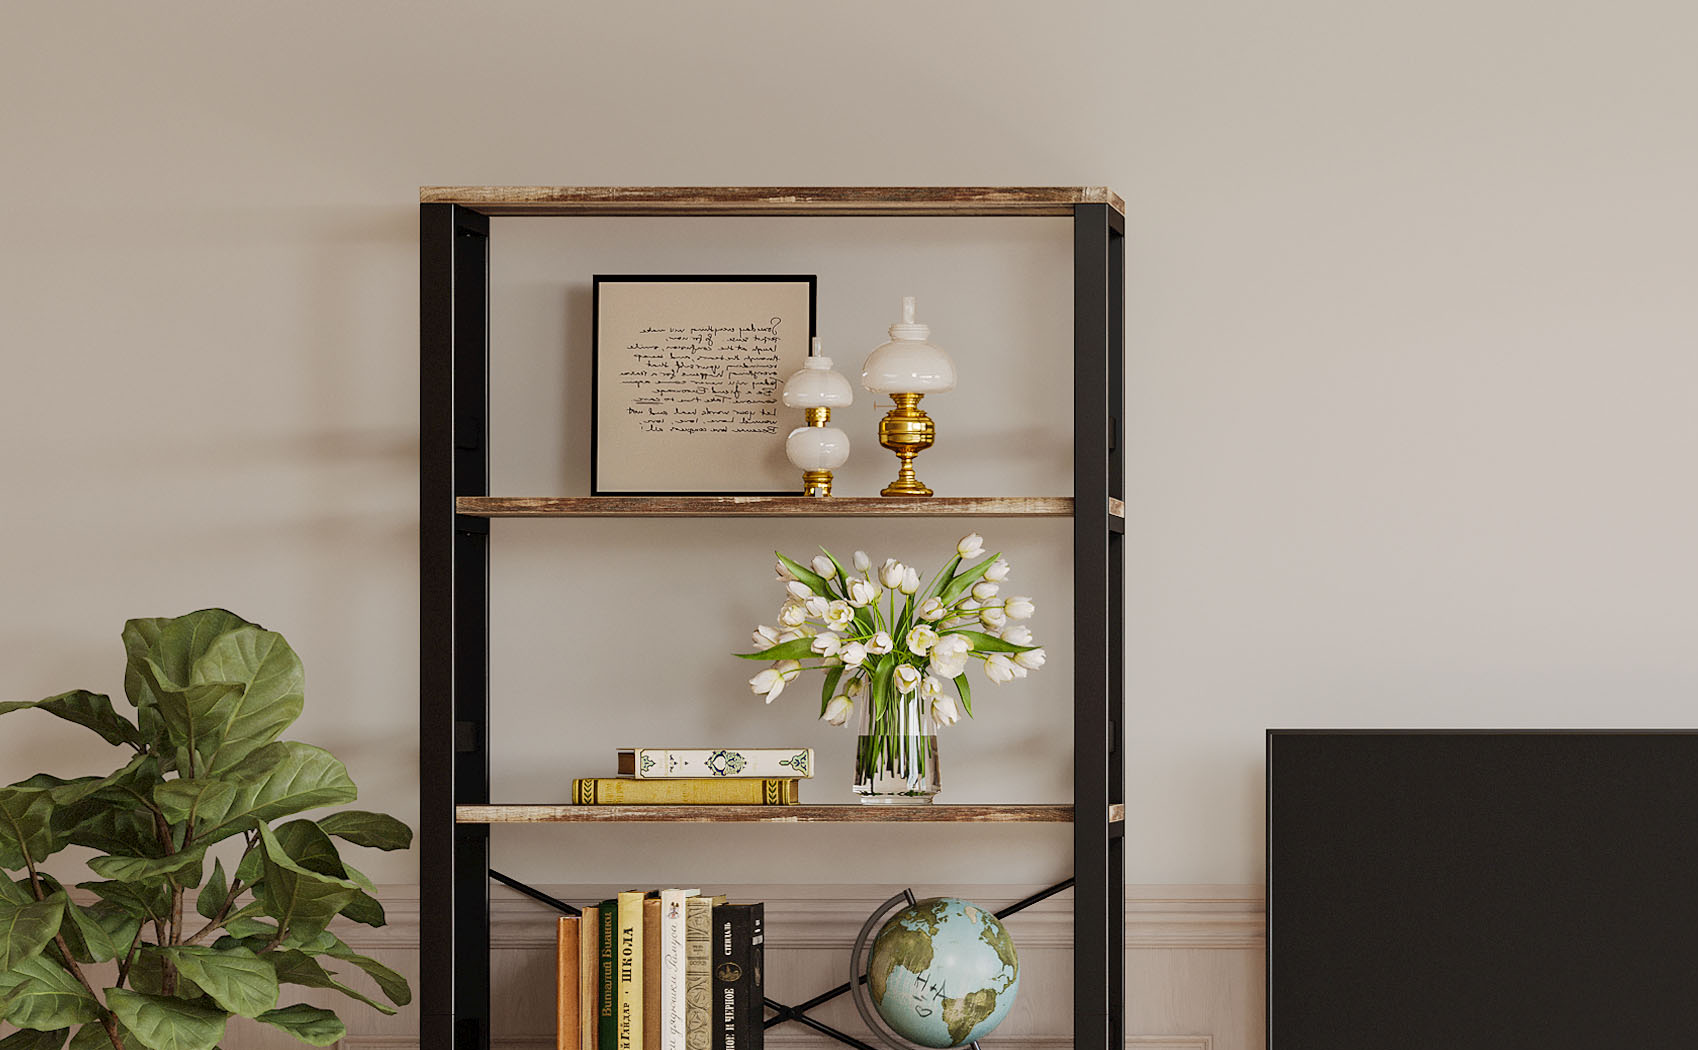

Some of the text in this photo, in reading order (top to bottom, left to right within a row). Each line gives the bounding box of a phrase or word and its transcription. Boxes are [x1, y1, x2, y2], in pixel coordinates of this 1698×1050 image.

[601, 911, 613, 1017] Виталий Бианки
[621, 927, 634, 983] ШКОЛА
[724, 988, 735, 1023] ЧЕРНОЕ
